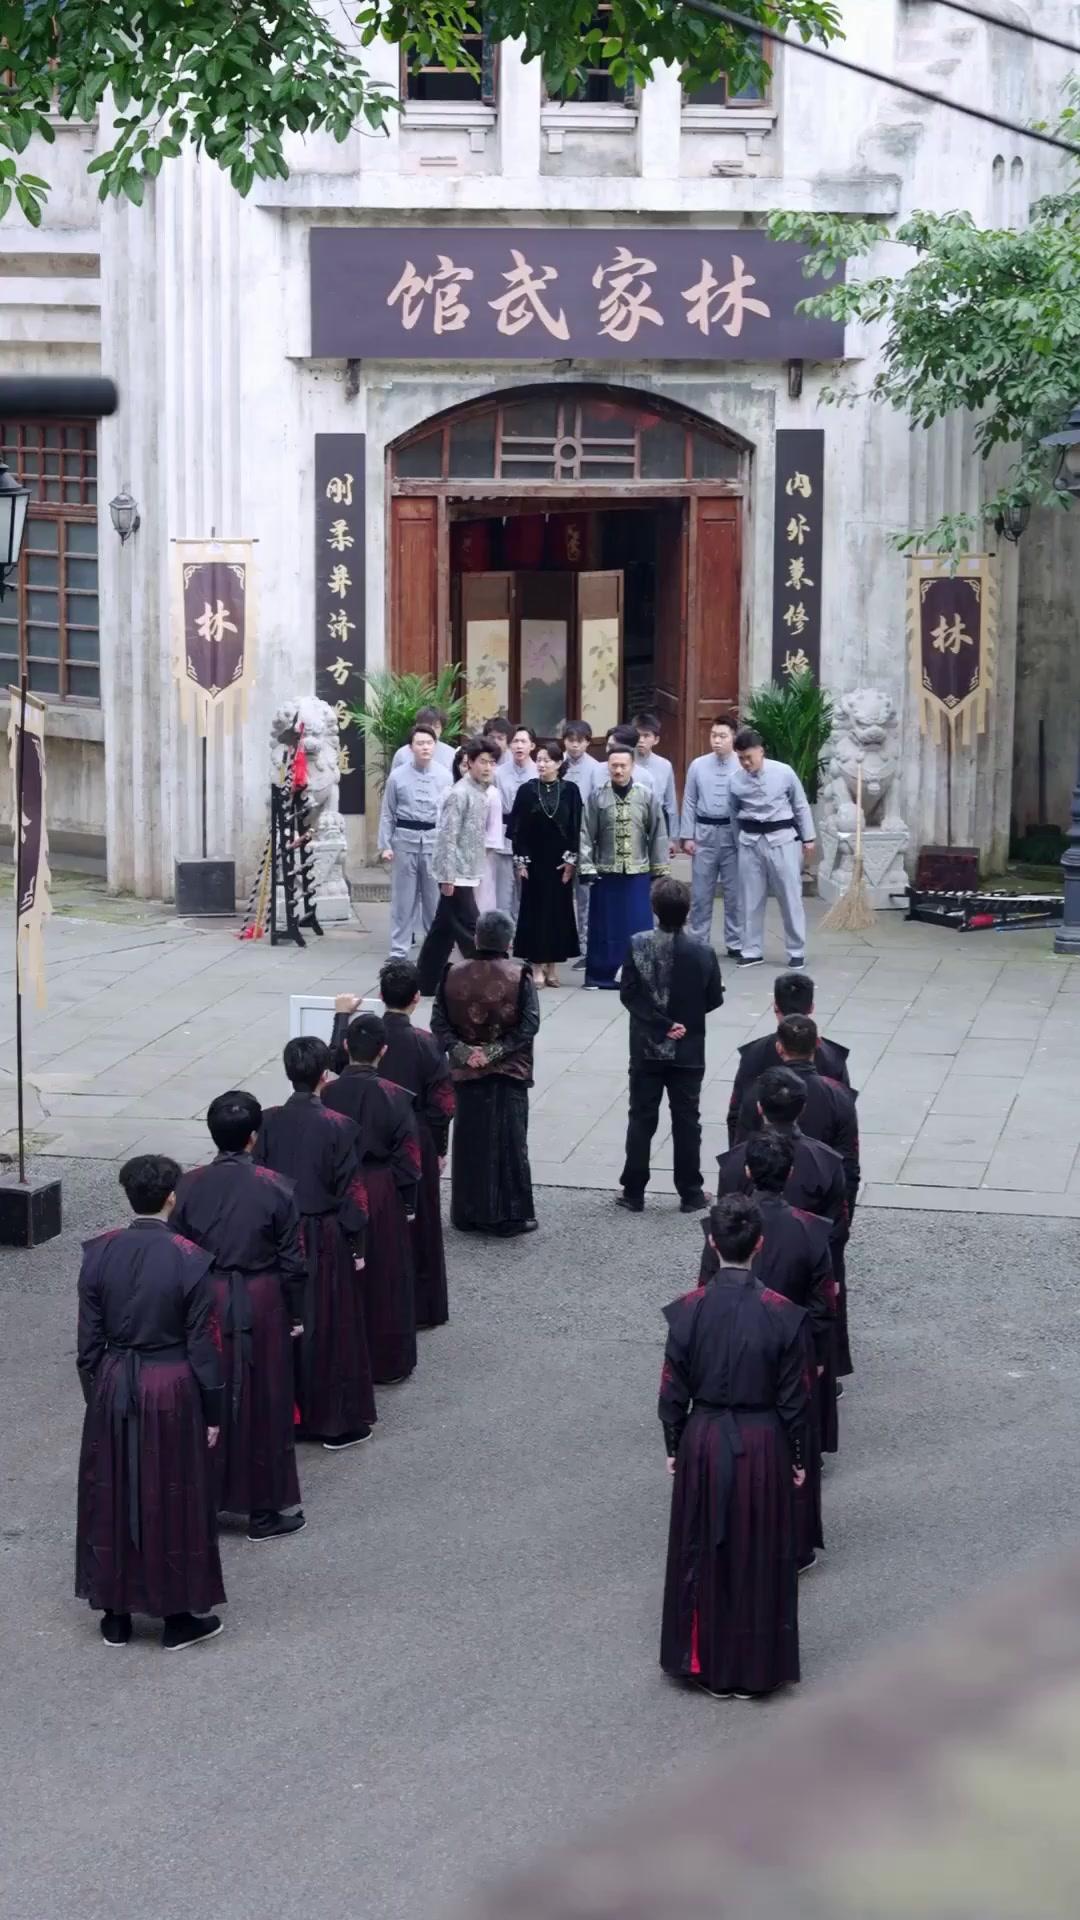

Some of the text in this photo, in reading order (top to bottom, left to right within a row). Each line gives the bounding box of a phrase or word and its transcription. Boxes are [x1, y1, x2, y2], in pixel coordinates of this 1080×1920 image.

[387, 246, 771, 342] 林家武馆
[194, 600, 238, 642] 林
[930, 612, 974, 654] 林
